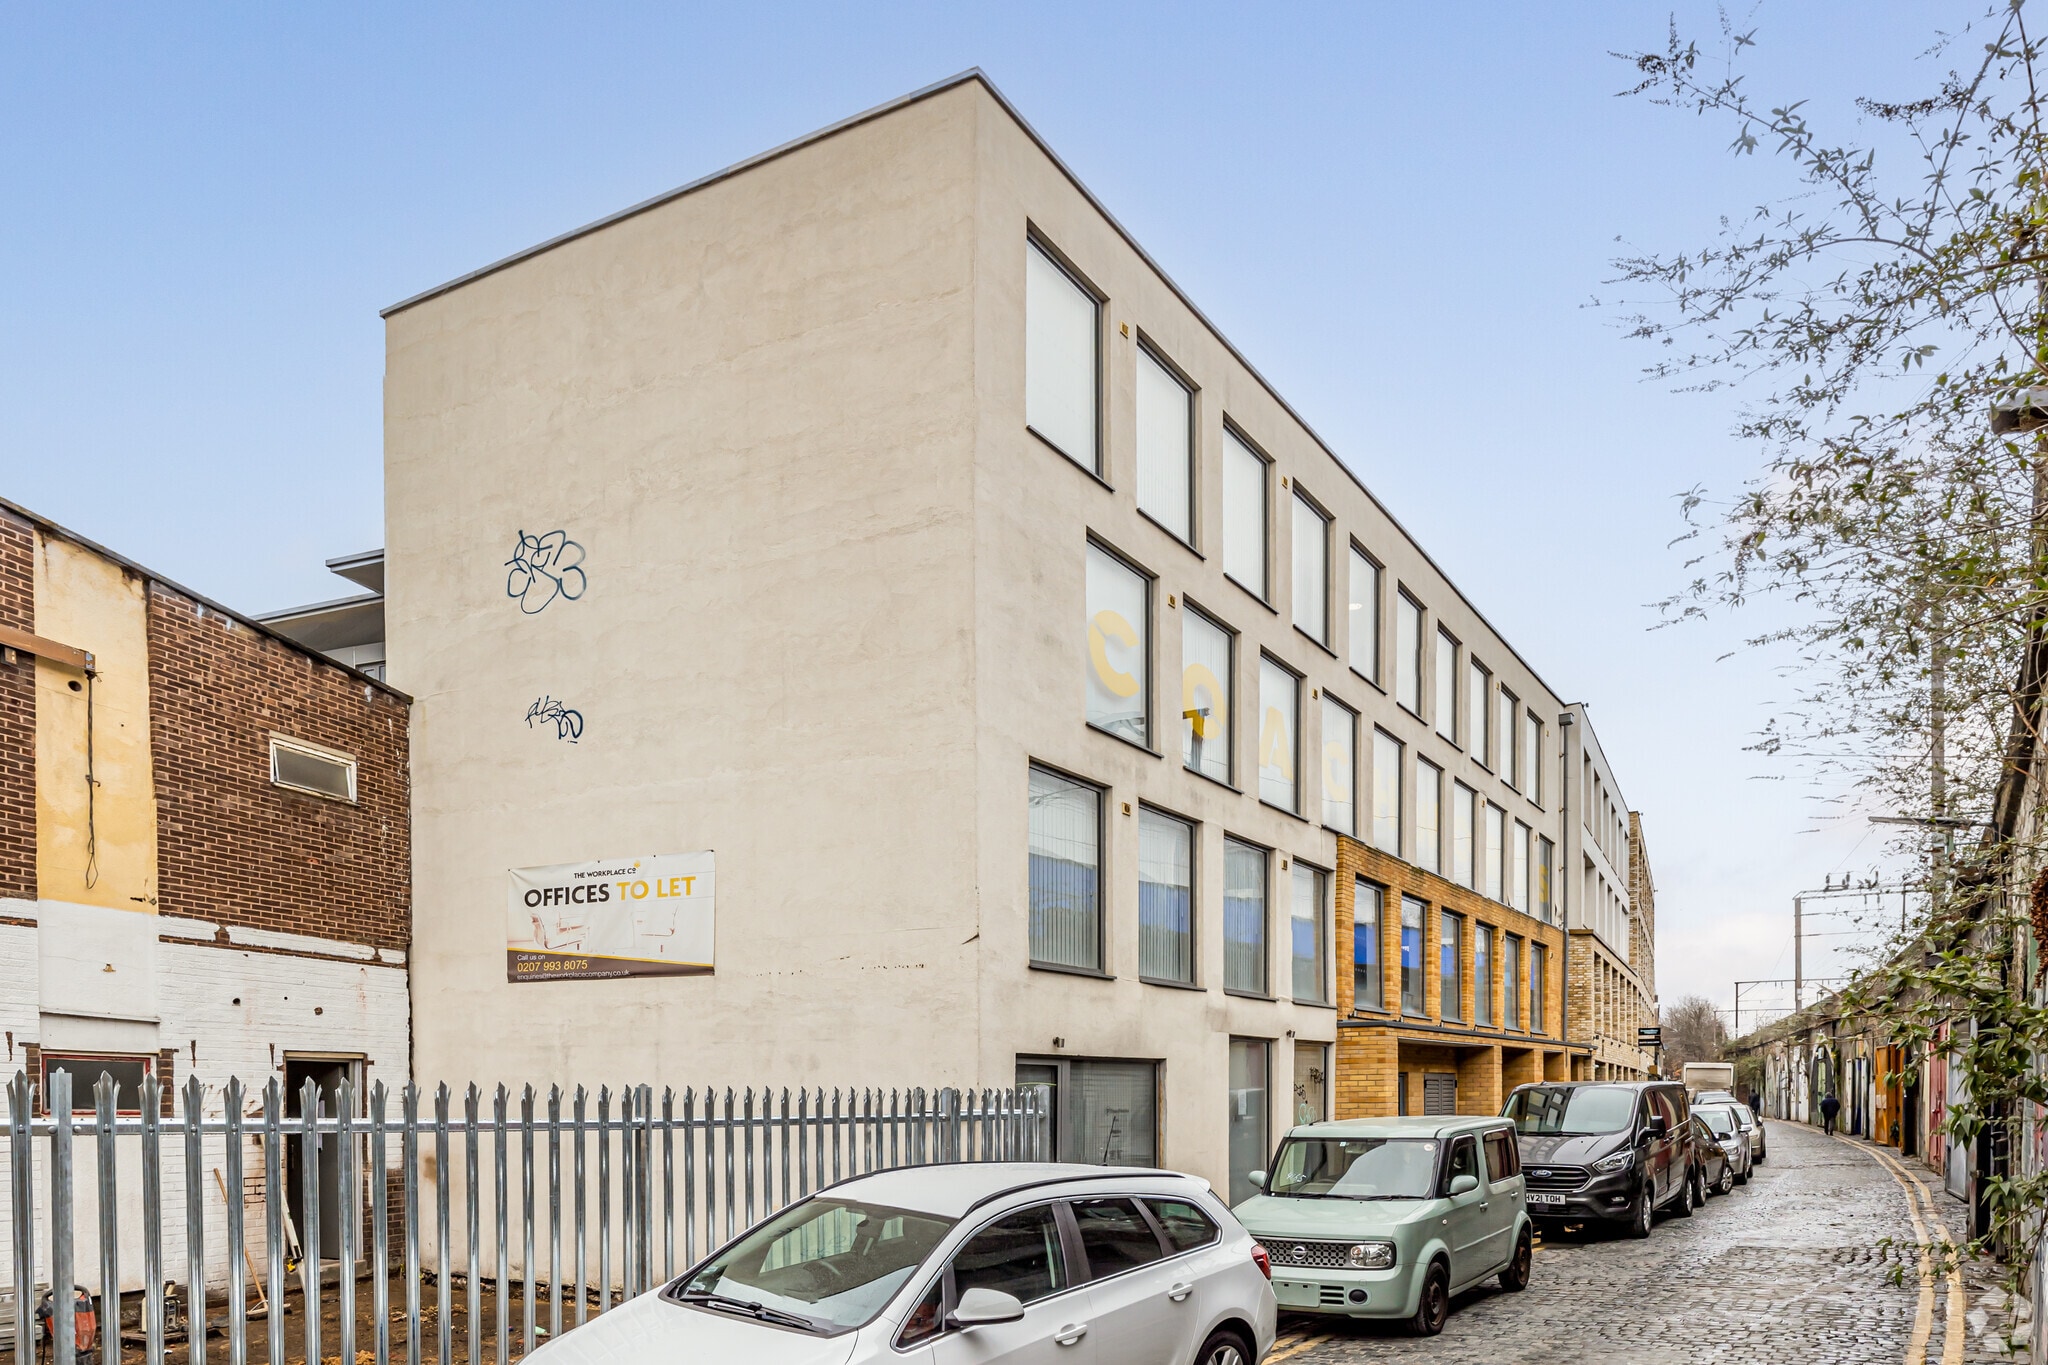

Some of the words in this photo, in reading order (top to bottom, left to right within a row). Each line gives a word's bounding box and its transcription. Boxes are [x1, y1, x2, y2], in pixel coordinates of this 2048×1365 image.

[587, 868, 626, 878] WORKPLACE
[524, 883, 610, 908] OFFICES
[616, 880, 650, 901] TO
[656, 875, 697, 898] LET
[516, 961, 540, 972] 0207
[543, 960, 561, 971] 993
[563, 959, 588, 970] 8075
[1544, 1195, 1561, 1203] TOH
